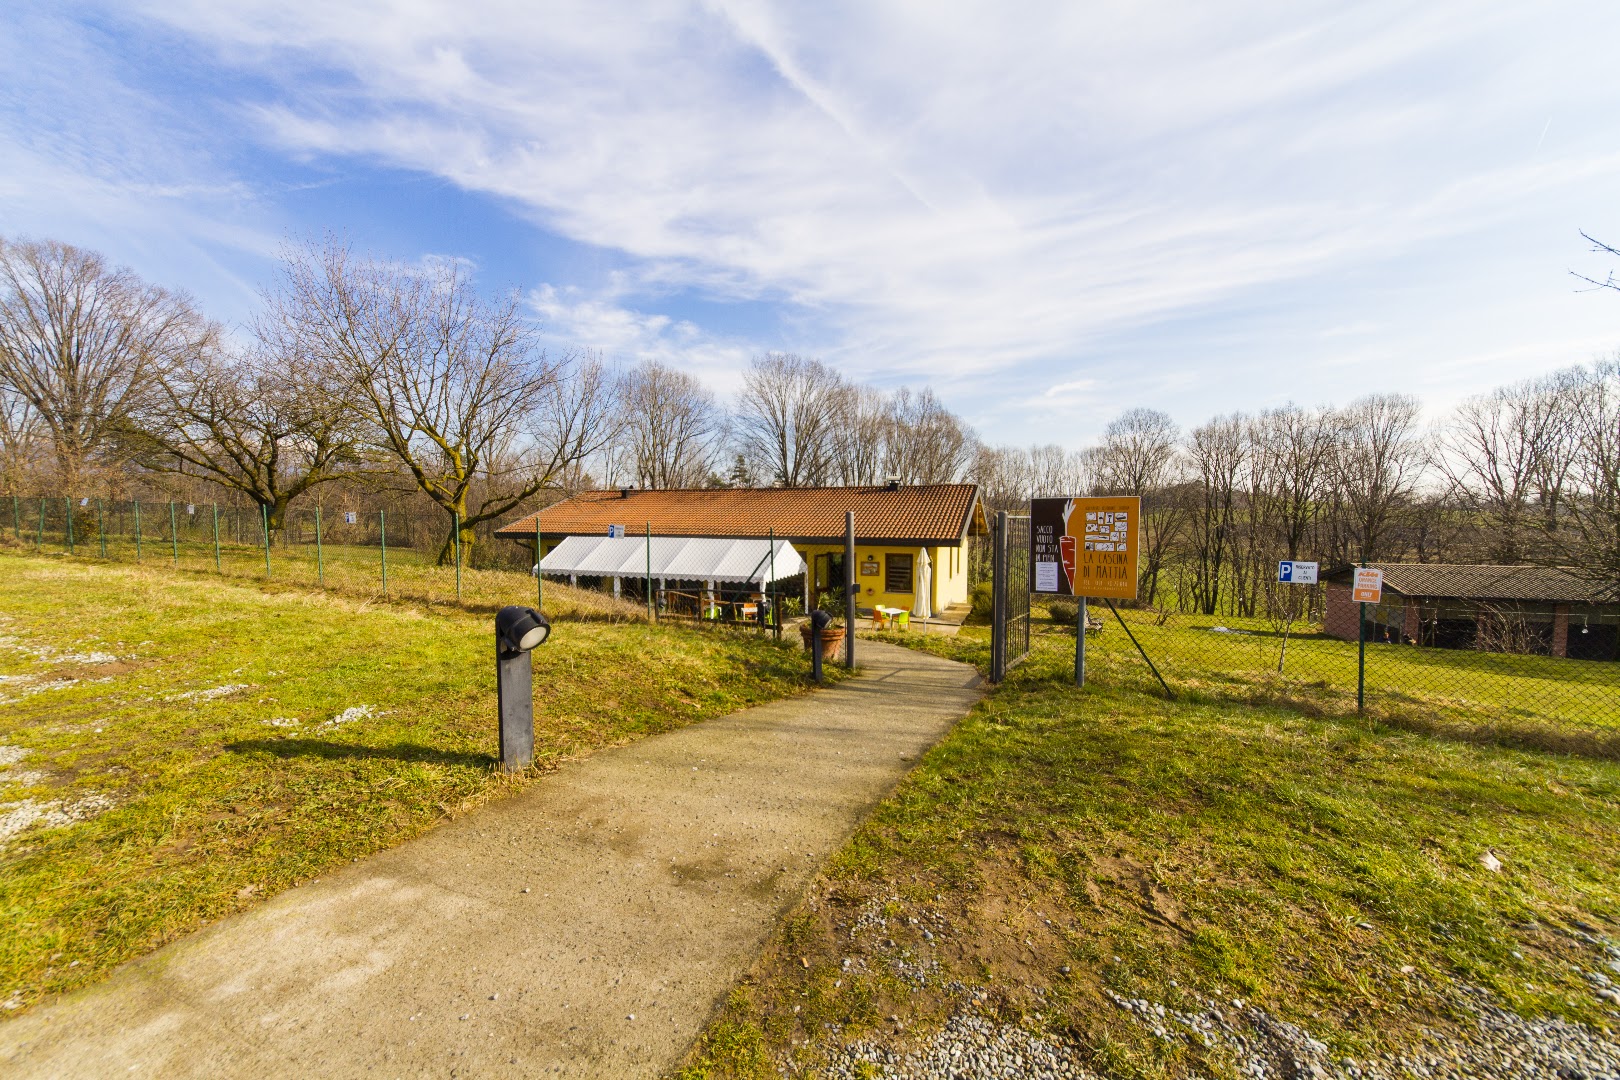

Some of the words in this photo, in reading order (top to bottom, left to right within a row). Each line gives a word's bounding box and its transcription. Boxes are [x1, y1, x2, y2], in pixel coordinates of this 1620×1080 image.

[607, 526, 614, 536] P
[1036, 525, 1053, 534] SACCO
[1036, 534, 1053, 544] VUOTO
[1036, 544, 1046, 553] NON
[1047, 544, 1059, 554] STA
[1036, 553, 1041, 562] IN
[1083, 553, 1094, 564] LA
[1098, 553, 1128, 565] CASCINA
[1083, 565, 1090, 578] DI
[1096, 565, 1128, 580] MATTIA
[1281, 564, 1292, 579] P
